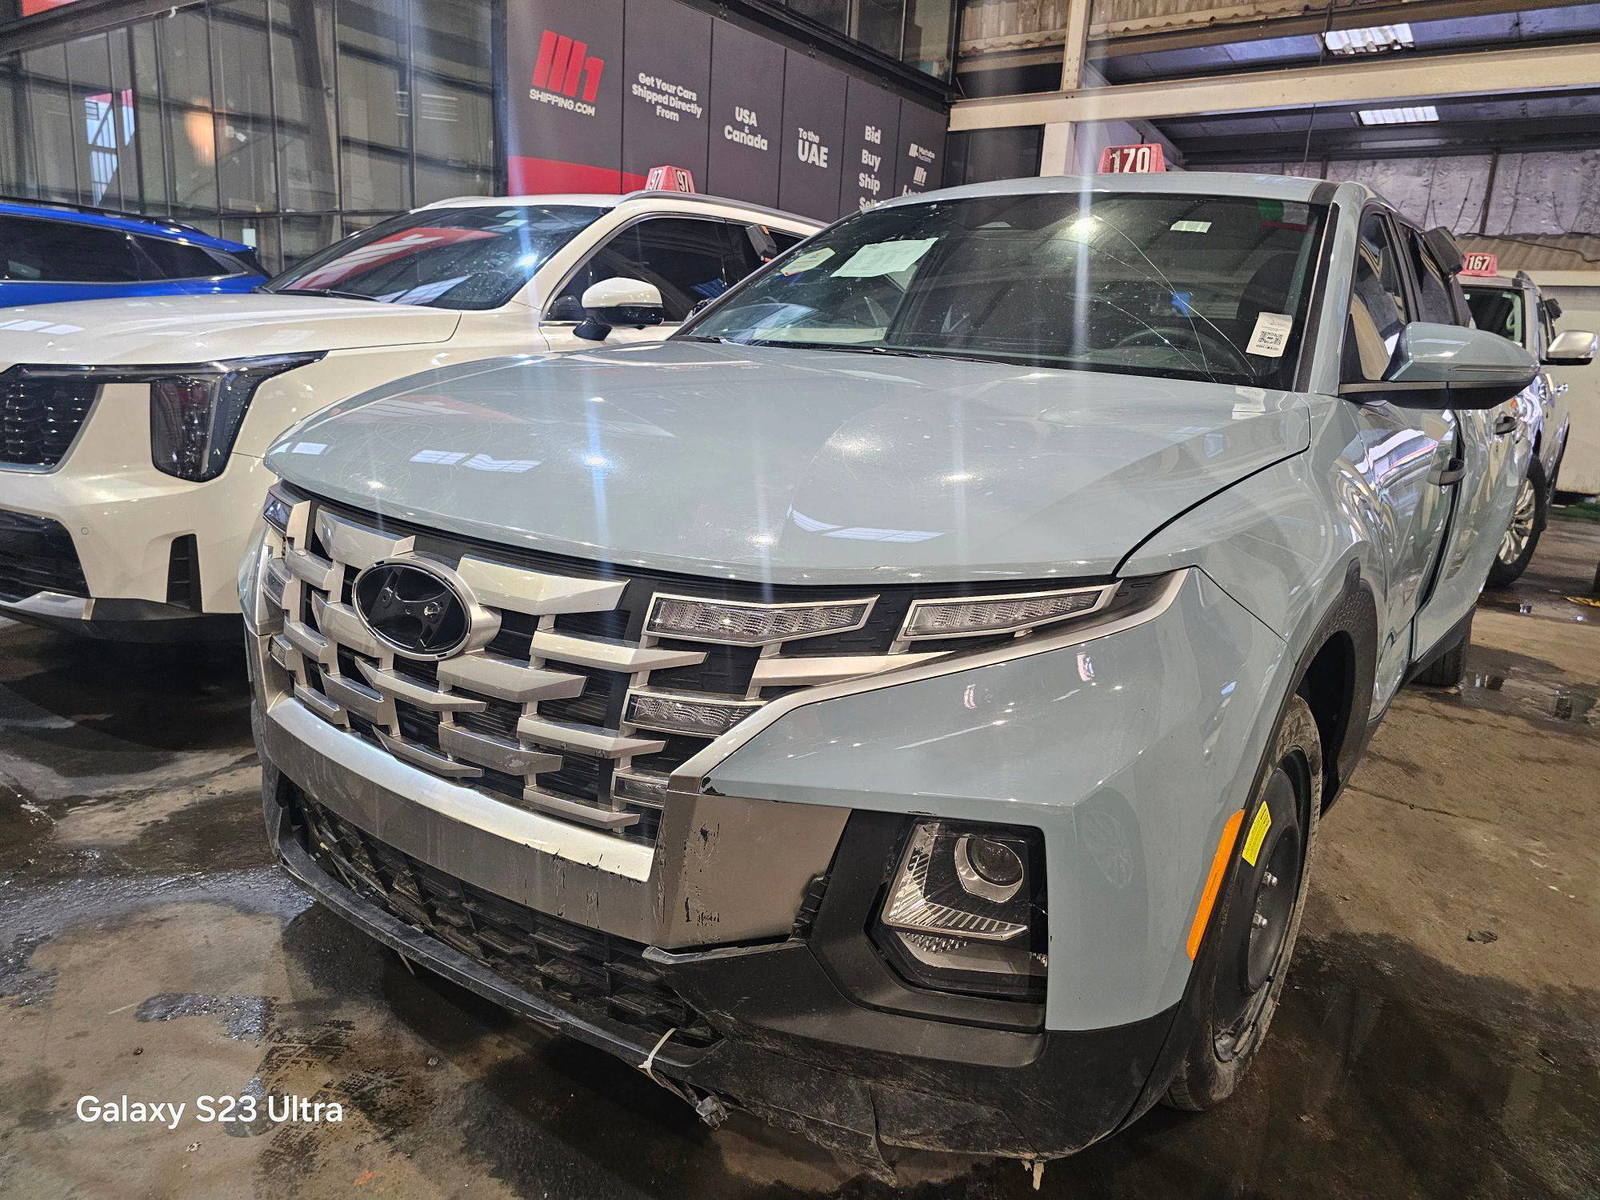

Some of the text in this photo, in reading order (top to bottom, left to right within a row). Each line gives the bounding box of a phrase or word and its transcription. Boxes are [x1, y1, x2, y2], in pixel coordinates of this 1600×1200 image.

[638, 72, 697, 101] Get Your Cars
[529, 89, 596, 117] SHIPPING.COM
[632, 83, 703, 119] Shipped Directly
[656, 105, 679, 122] From
[735, 105, 758, 127] USA
[724, 125, 768, 151] Canada
[798, 127, 820, 144] To the
[864, 125, 881, 144] Bid
[797, 138, 829, 168] UAE
[861, 149, 881, 172] Buy
[1110, 147, 1150, 173] 170
[858, 172, 880, 196] Ship
[1468, 256, 1491, 271] 167
